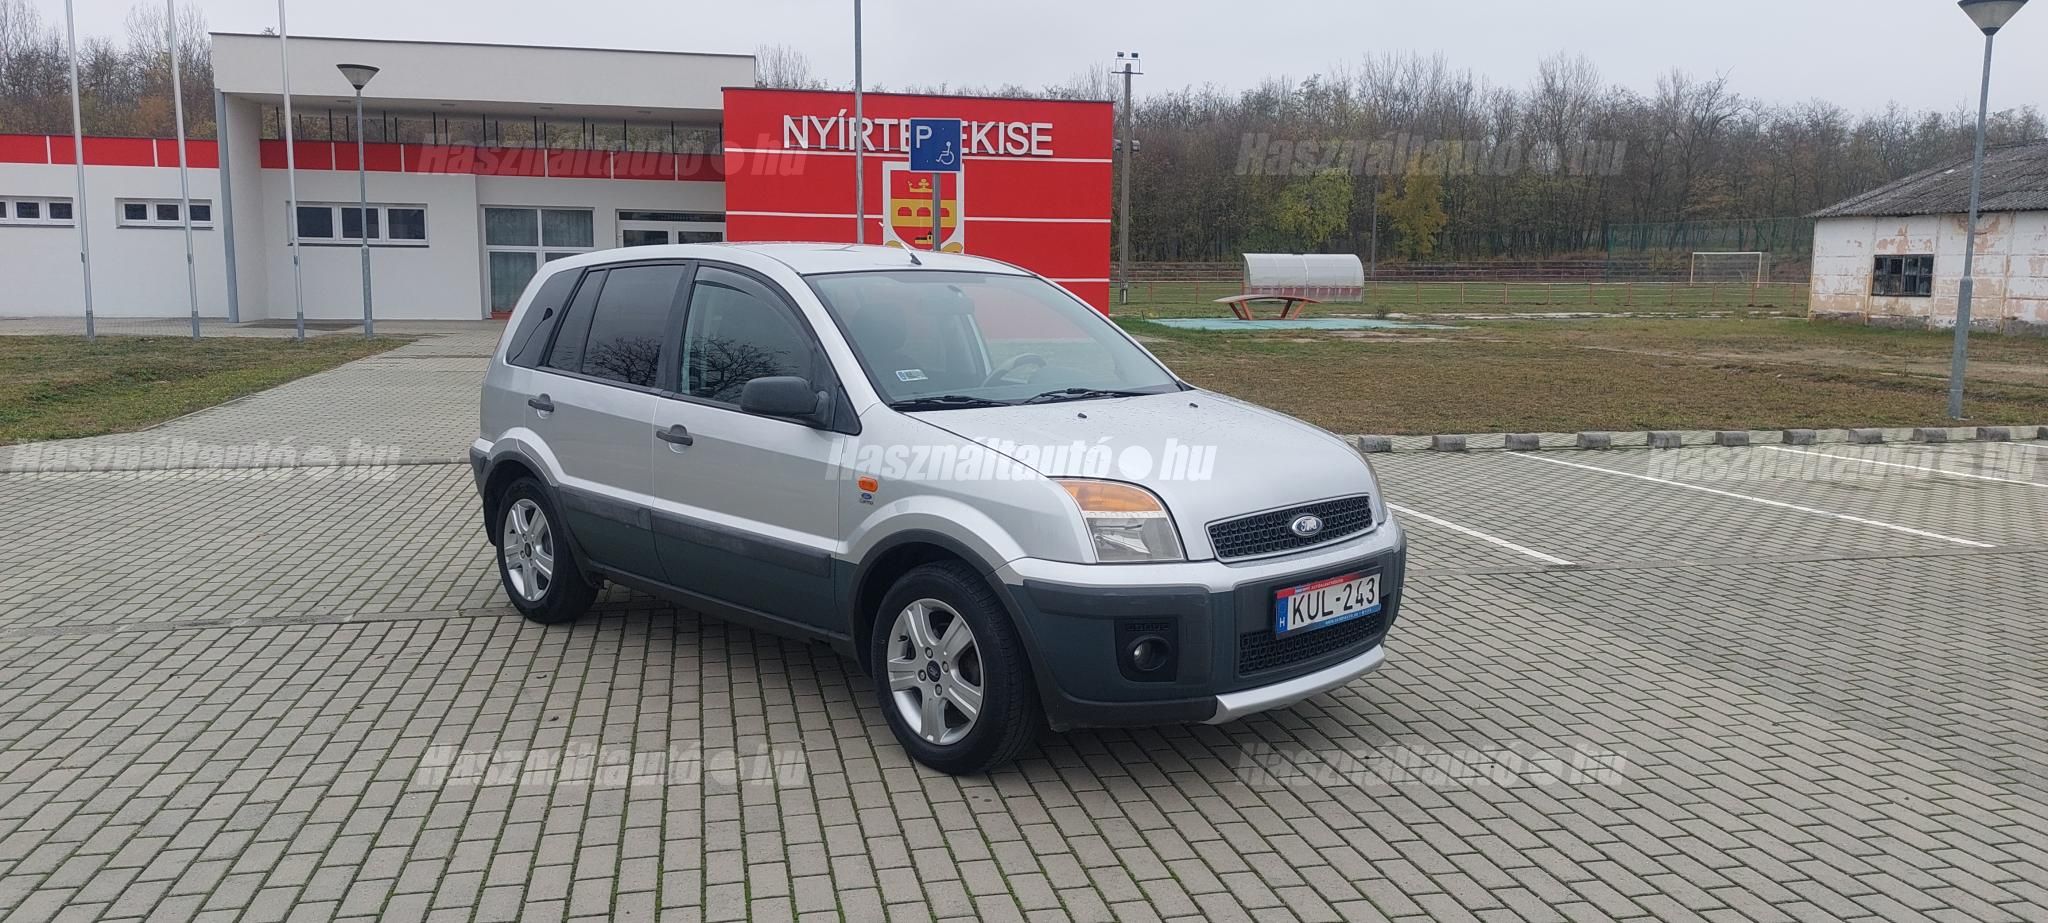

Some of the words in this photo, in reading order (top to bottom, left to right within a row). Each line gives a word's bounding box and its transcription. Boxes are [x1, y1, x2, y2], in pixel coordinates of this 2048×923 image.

[783, 108, 1054, 156] NYÍRTEKISE
[916, 126, 933, 149] P
[1293, 577, 1375, 625] KUL-243
[1279, 617, 1286, 628] H
